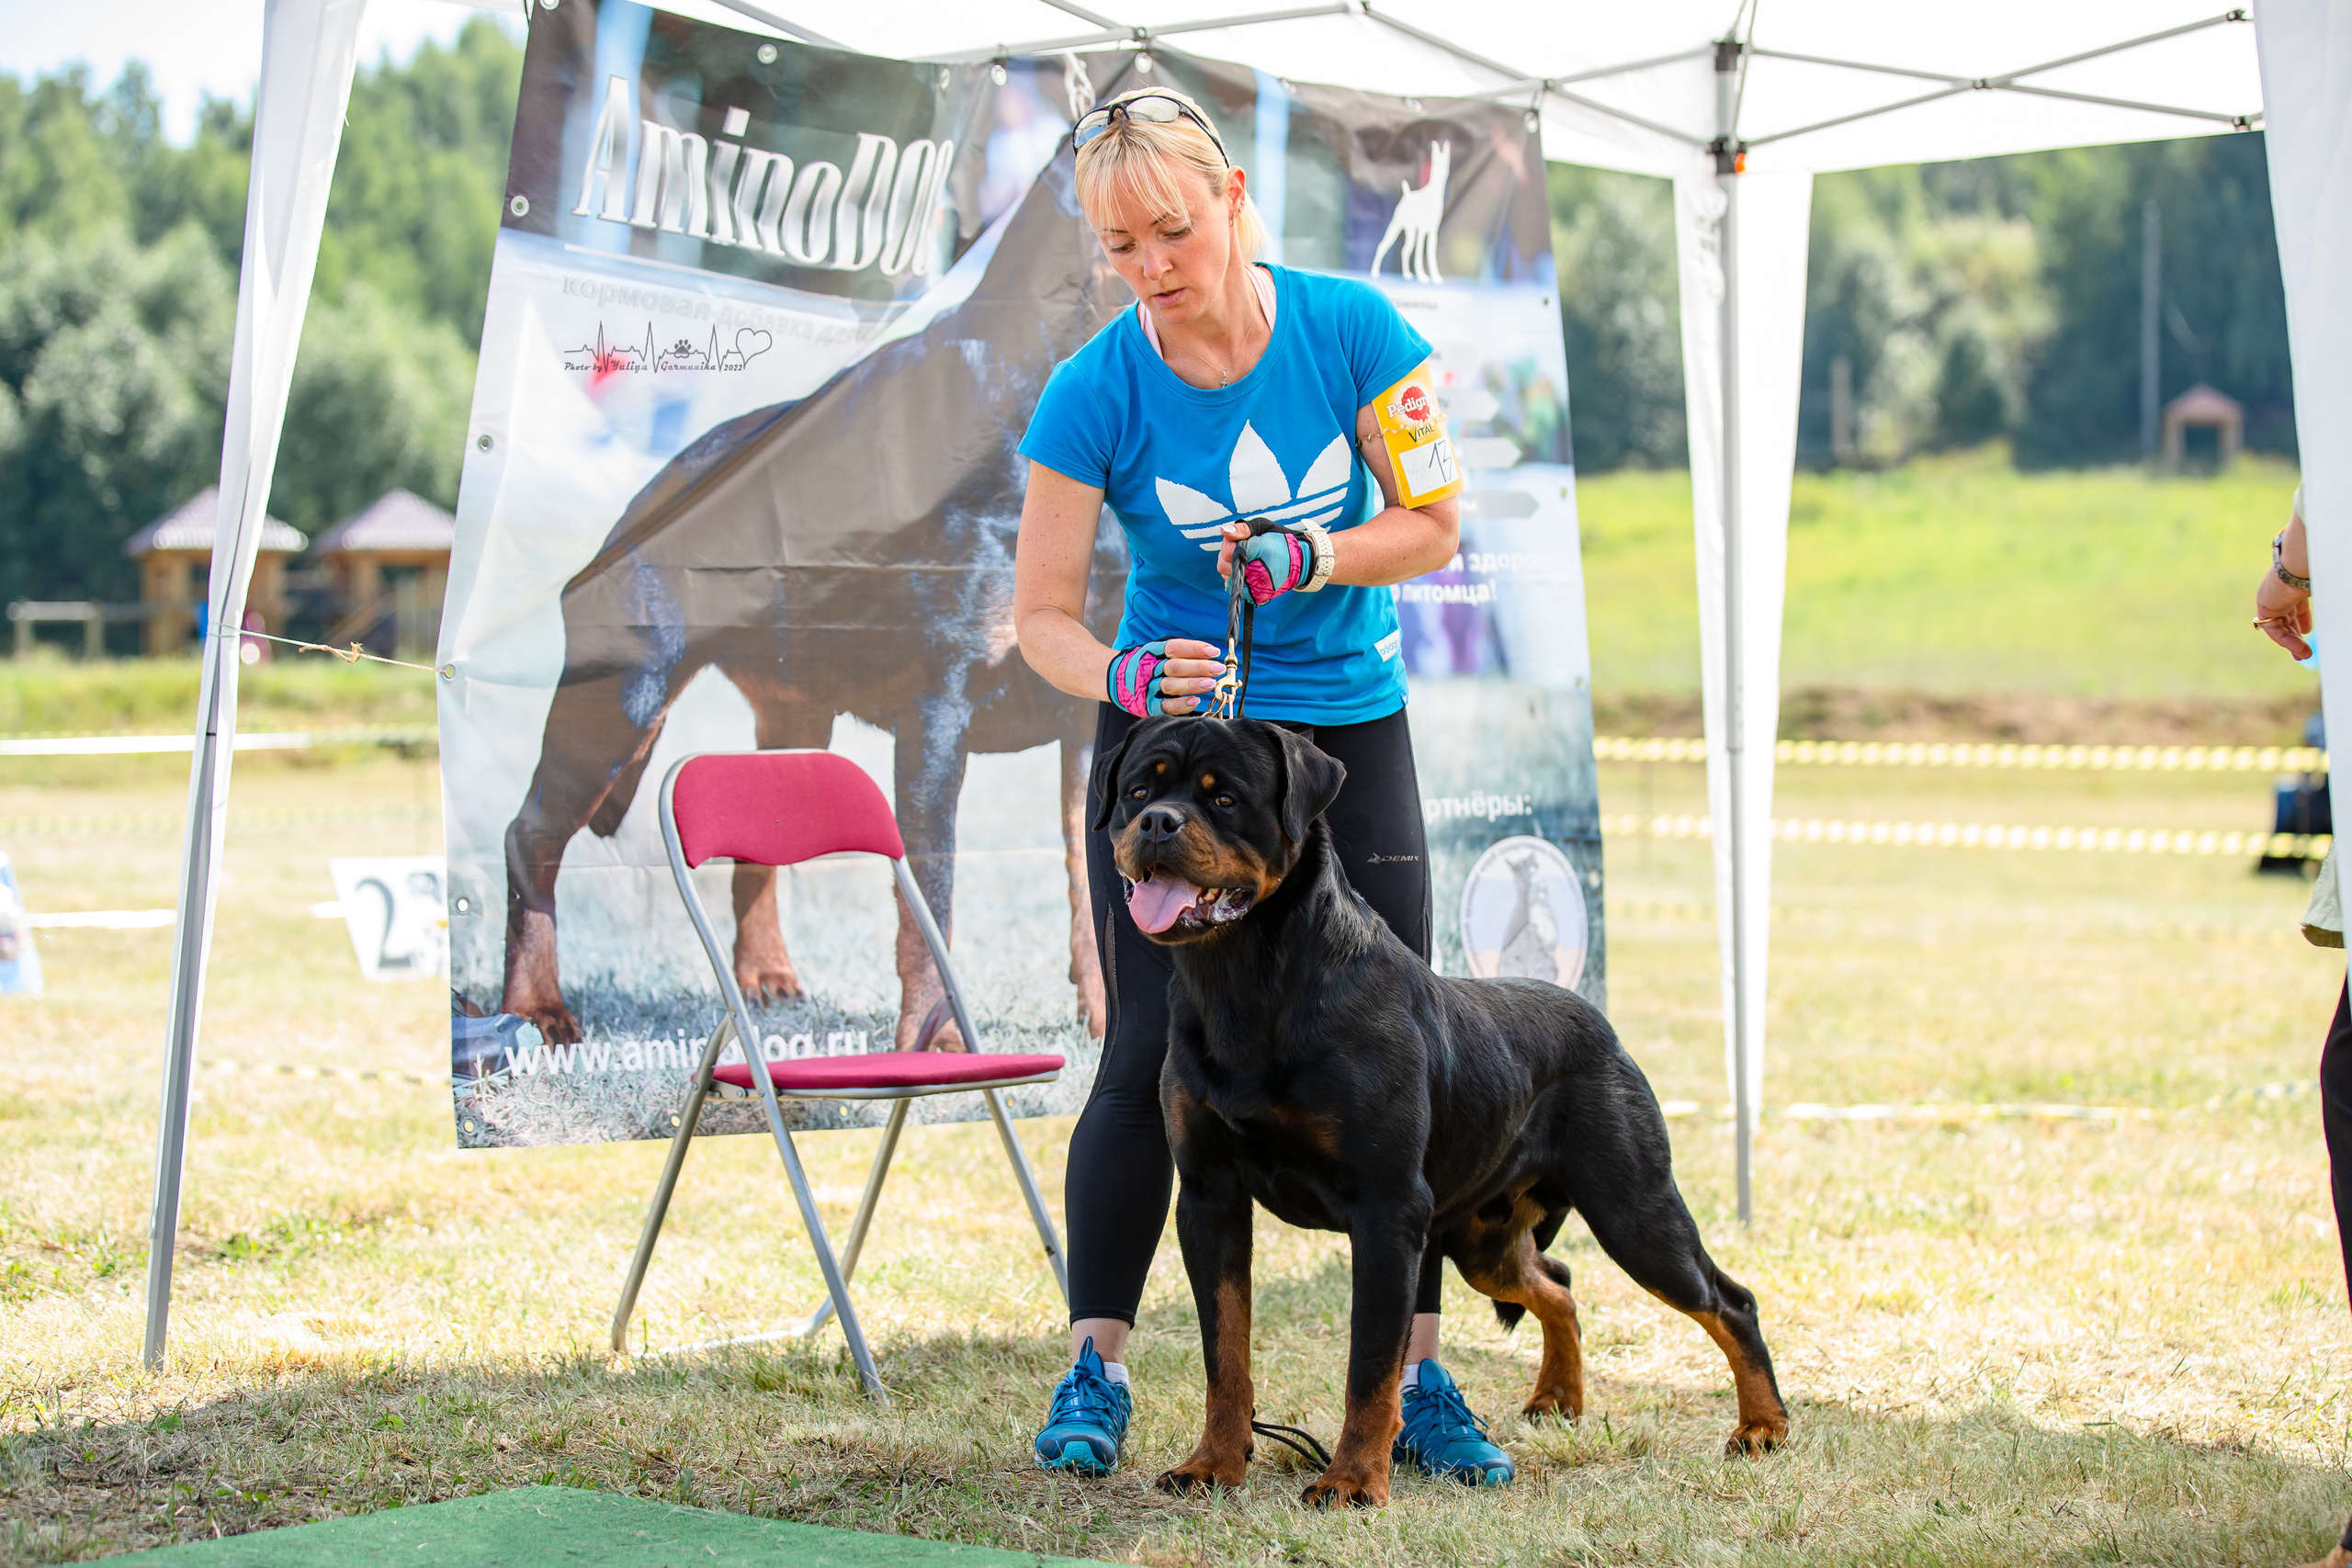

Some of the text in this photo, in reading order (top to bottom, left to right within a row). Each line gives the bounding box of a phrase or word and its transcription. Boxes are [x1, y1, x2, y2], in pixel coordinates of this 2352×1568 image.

[562, 276, 711, 321] кормовая
[1408, 423, 1435, 443] VITAL
[1467, 551, 1539, 575] здоро
[1401, 579, 1498, 607] питомца!
[1425, 789, 1532, 823] ртнёры:
[1380, 854, 1420, 863] DEMIX
[504, 1025, 868, 1076] www.aminoog.ru
